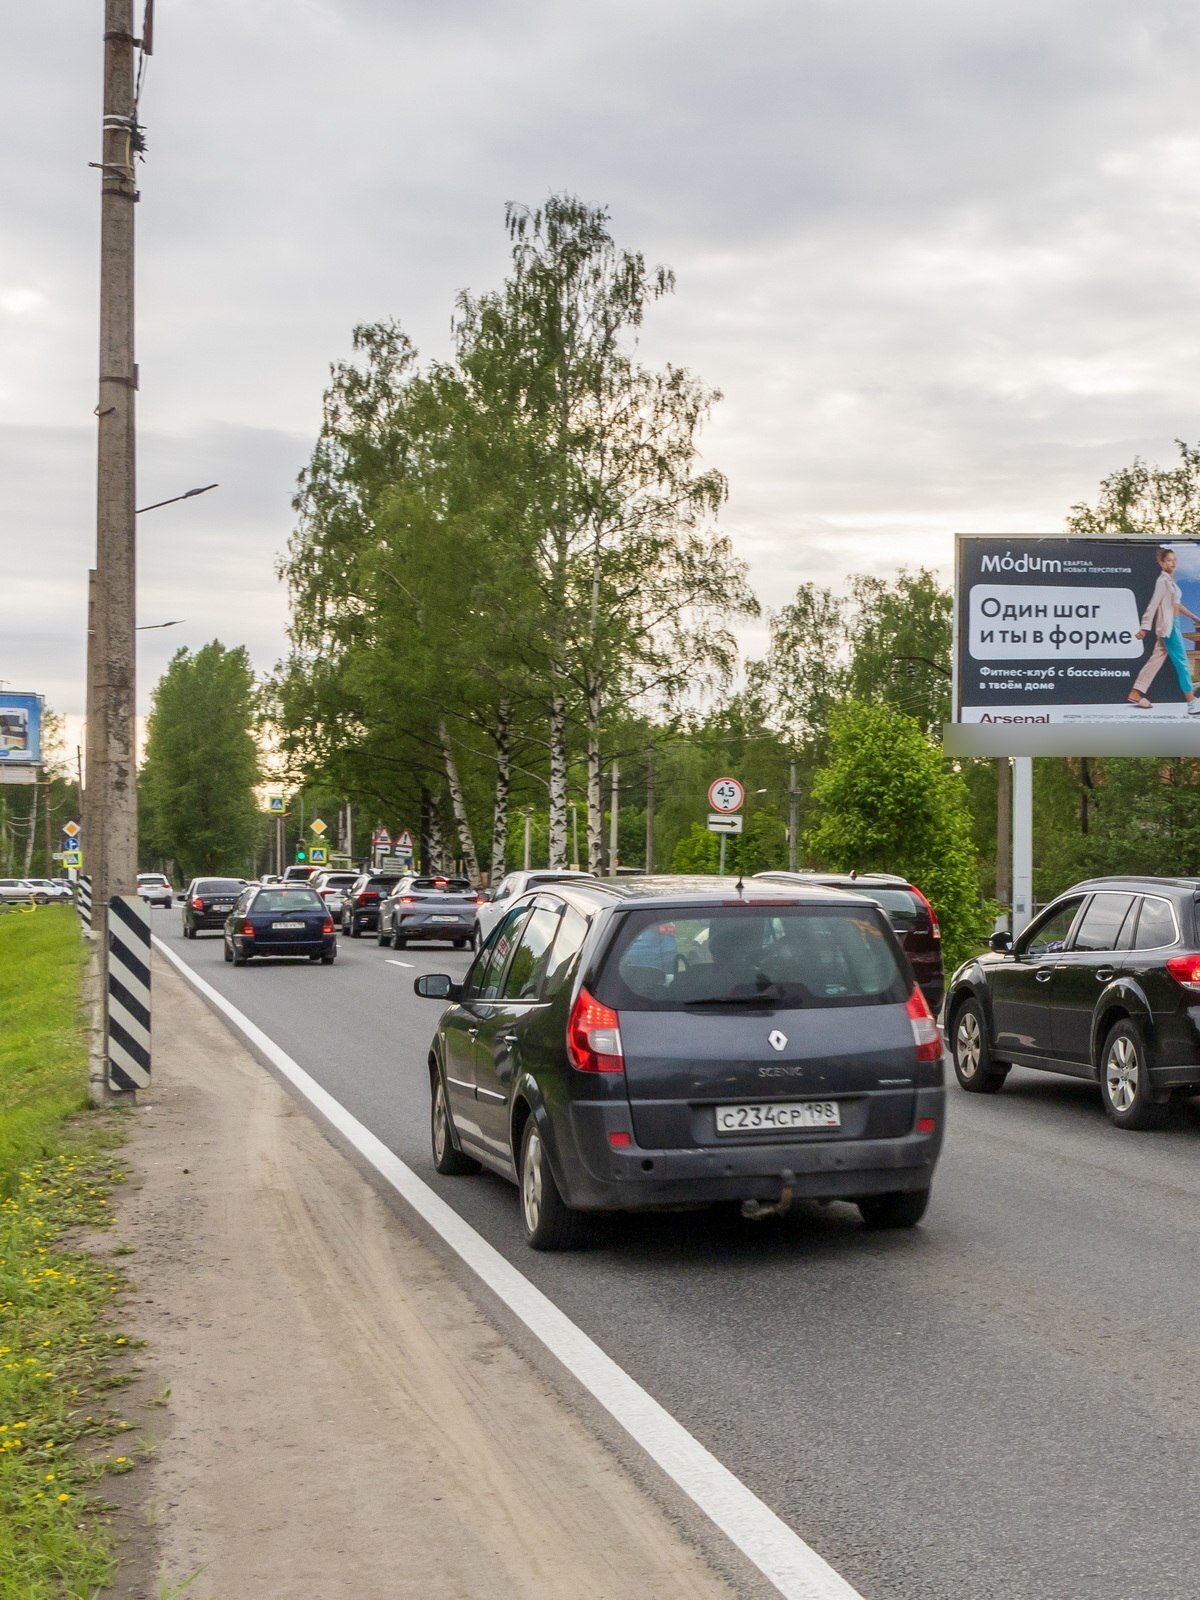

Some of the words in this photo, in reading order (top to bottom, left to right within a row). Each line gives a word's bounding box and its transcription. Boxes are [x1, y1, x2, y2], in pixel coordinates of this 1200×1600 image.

[981, 551, 1062, 573] Módum
[980, 597, 1048, 621] Один
[1053, 604, 1101, 619] шаг
[980, 627, 995, 644] и
[999, 627, 1028, 644] ты
[1033, 627, 1043, 644] в
[1049, 624, 1133, 650] форме
[979, 666, 1056, 680] Фитнес-клуб
[1058, 669, 1065, 677] с
[1067, 666, 1131, 678] бассейном
[979, 682, 986, 690] в
[988, 680, 1023, 690] твоём
[1025, 682, 1056, 691] доме
[980, 713, 1051, 724] Arsenal
[758, 1066, 804, 1078] SCENIC
[807, 1101, 834, 1120] 198
